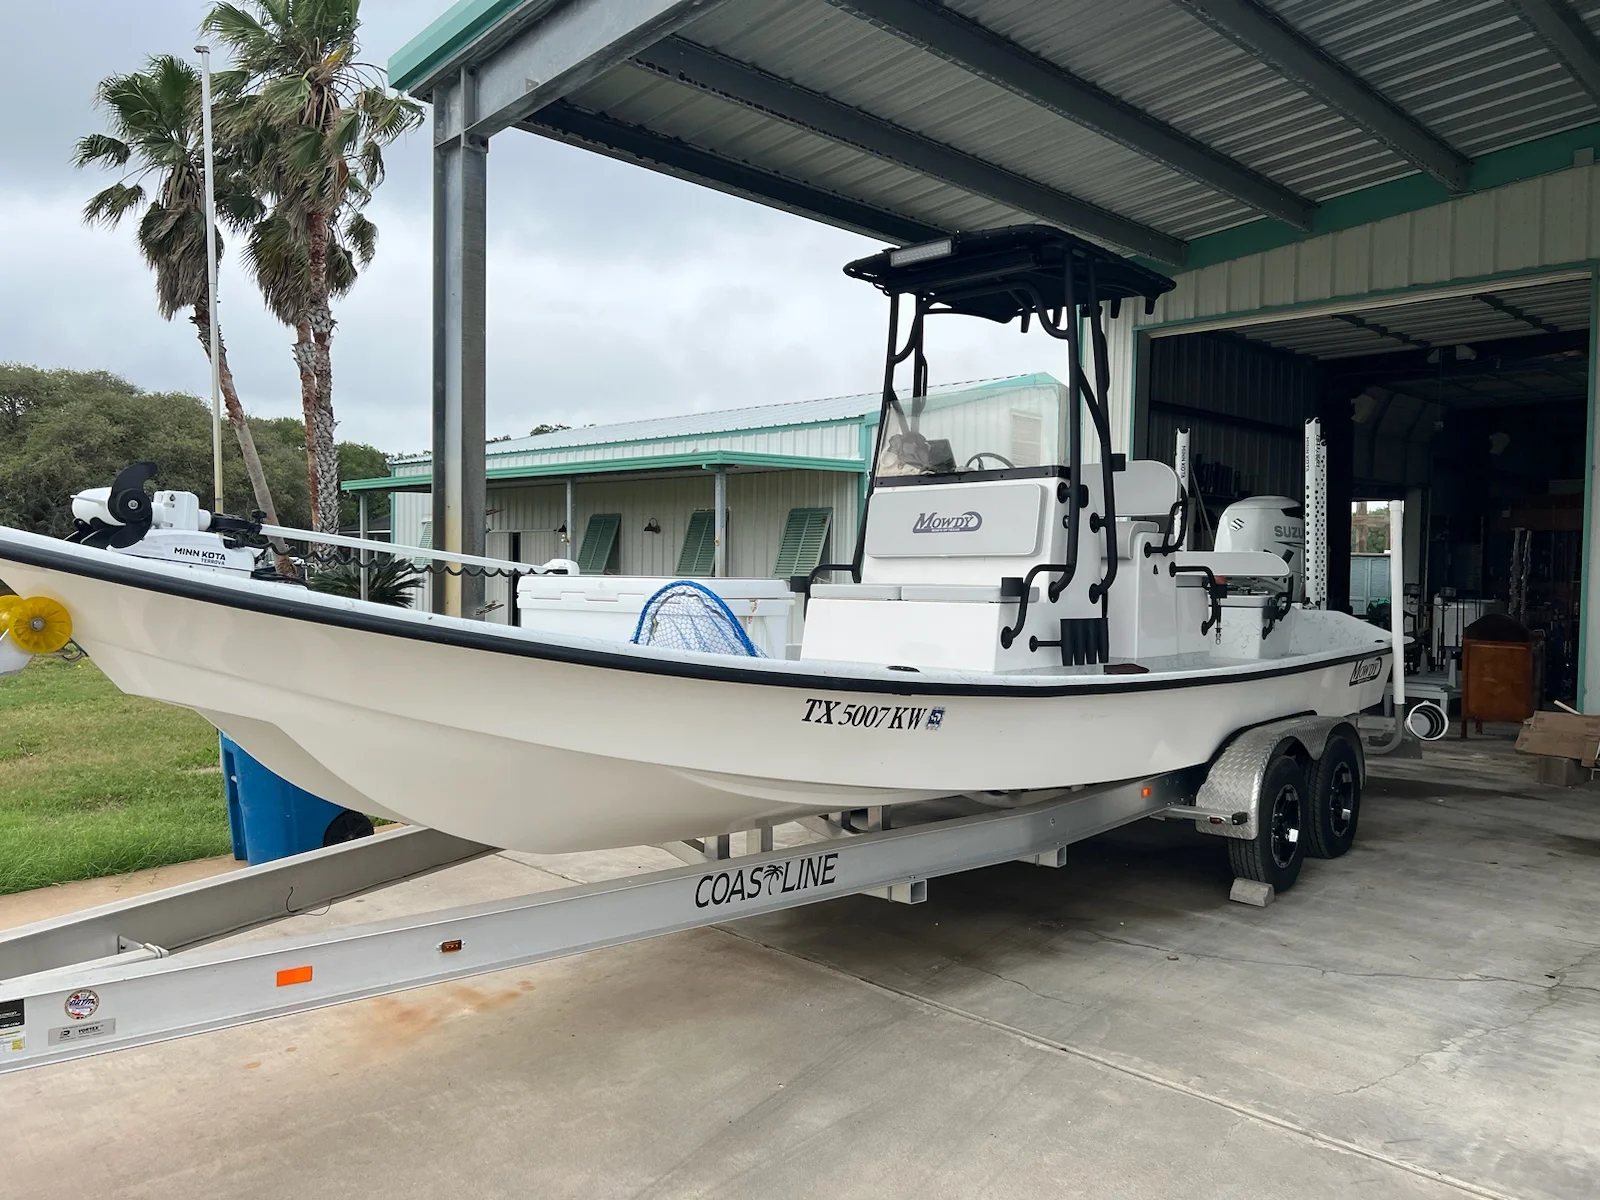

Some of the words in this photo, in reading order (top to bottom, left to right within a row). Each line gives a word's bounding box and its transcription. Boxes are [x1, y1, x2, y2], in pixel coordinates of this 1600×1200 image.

[1274, 525, 1304, 539] SUZU
[174, 547, 200, 557] MINN
[201, 550, 226, 561] KOTA
[801, 698, 841, 725] TX
[838, 704, 892, 728] 5007
[887, 706, 928, 730] KW
